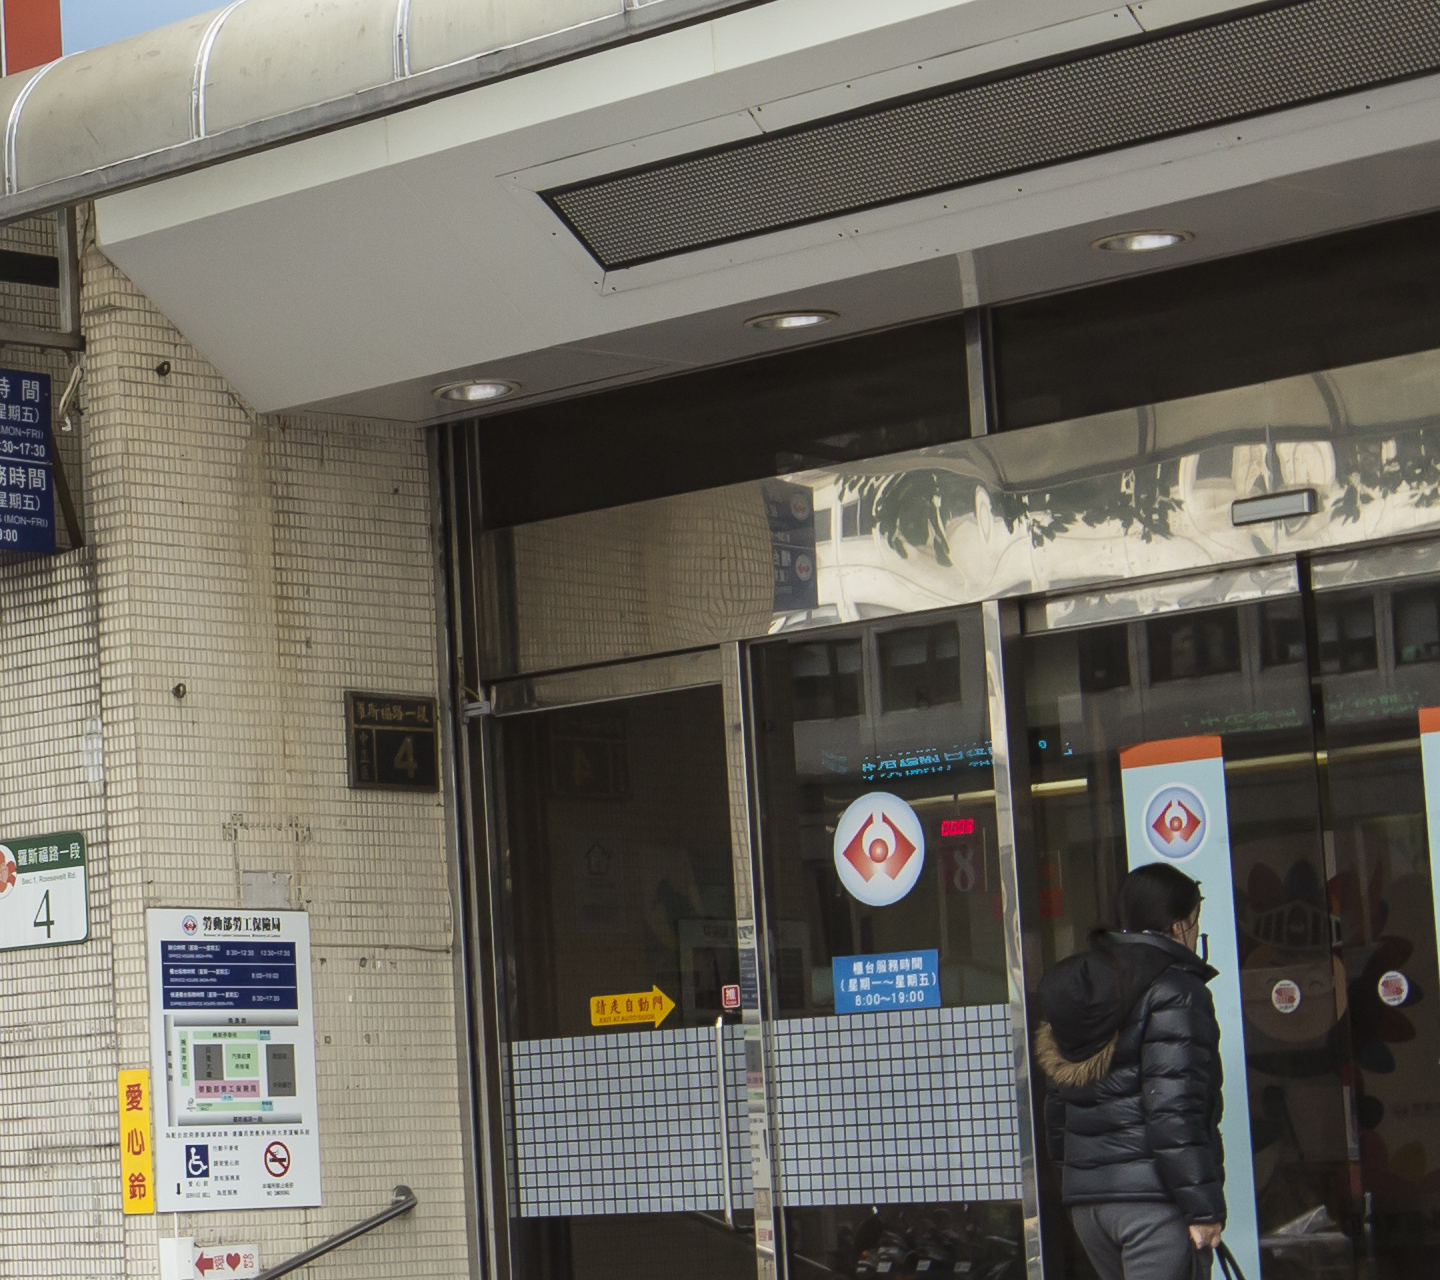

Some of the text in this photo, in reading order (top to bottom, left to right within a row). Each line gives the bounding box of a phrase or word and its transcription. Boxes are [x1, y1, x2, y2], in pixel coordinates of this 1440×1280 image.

[393, 735, 418, 778] 4
[17, 842, 81, 866] 羅斯福路一段
[33, 889, 55, 939] 4
[852, 957, 923, 975] 櫃台服務時間
[595, 995, 664, 1015] 請走自動門
[855, 990, 925, 1007] 8:00~19:00
[125, 1082, 146, 1200] 愛心鈴
